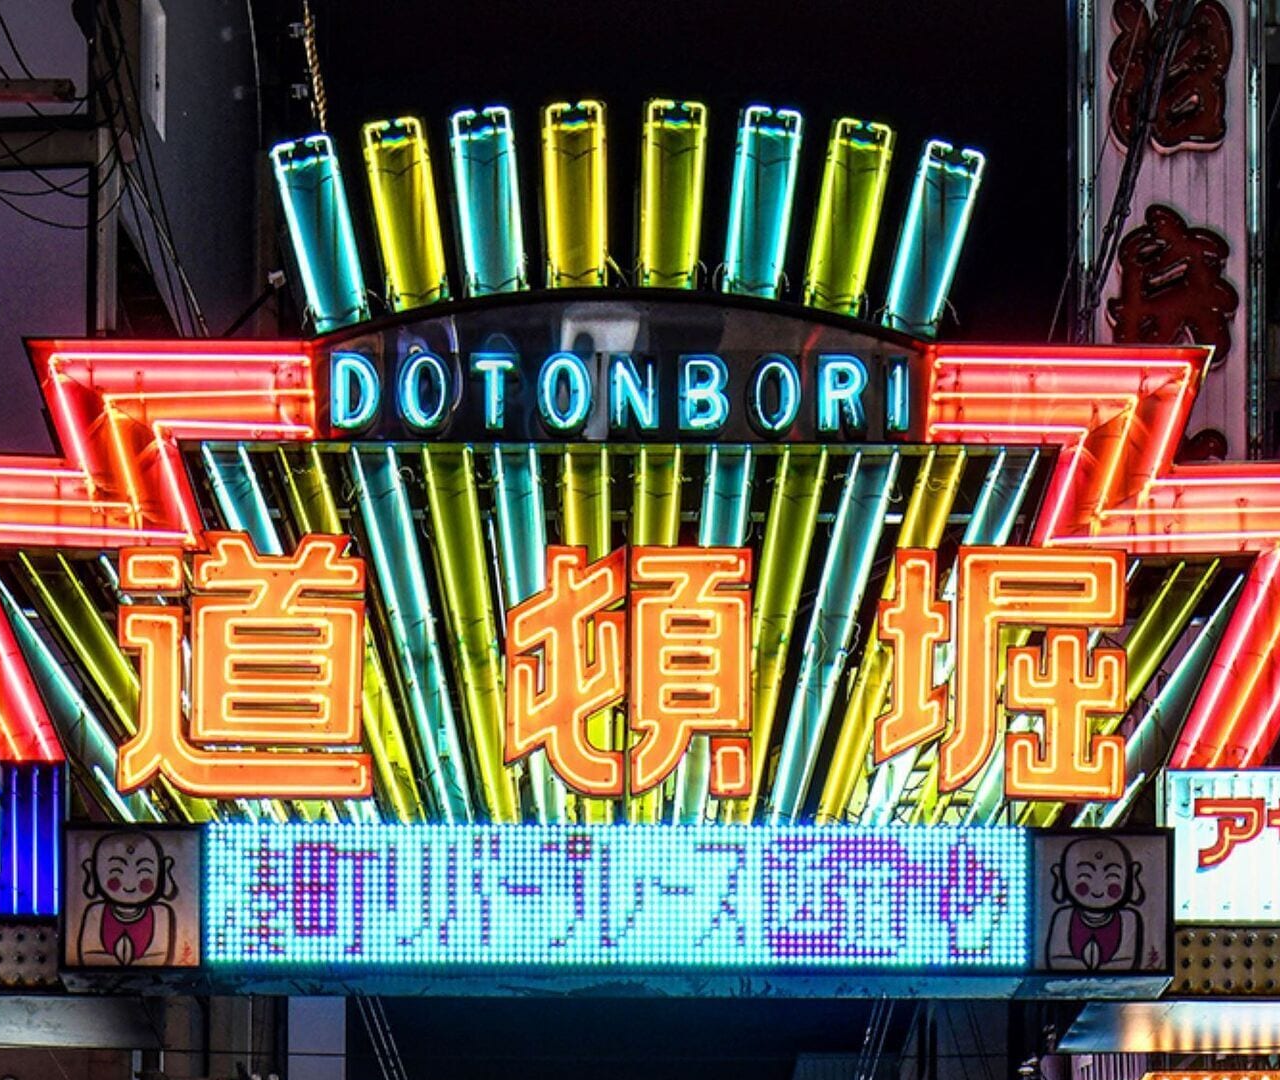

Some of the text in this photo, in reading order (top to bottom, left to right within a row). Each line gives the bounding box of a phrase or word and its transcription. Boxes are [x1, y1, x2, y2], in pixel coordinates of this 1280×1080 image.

[329, 353, 909, 431] DOTONBORI
[118, 531, 1127, 798] 道頓堀
